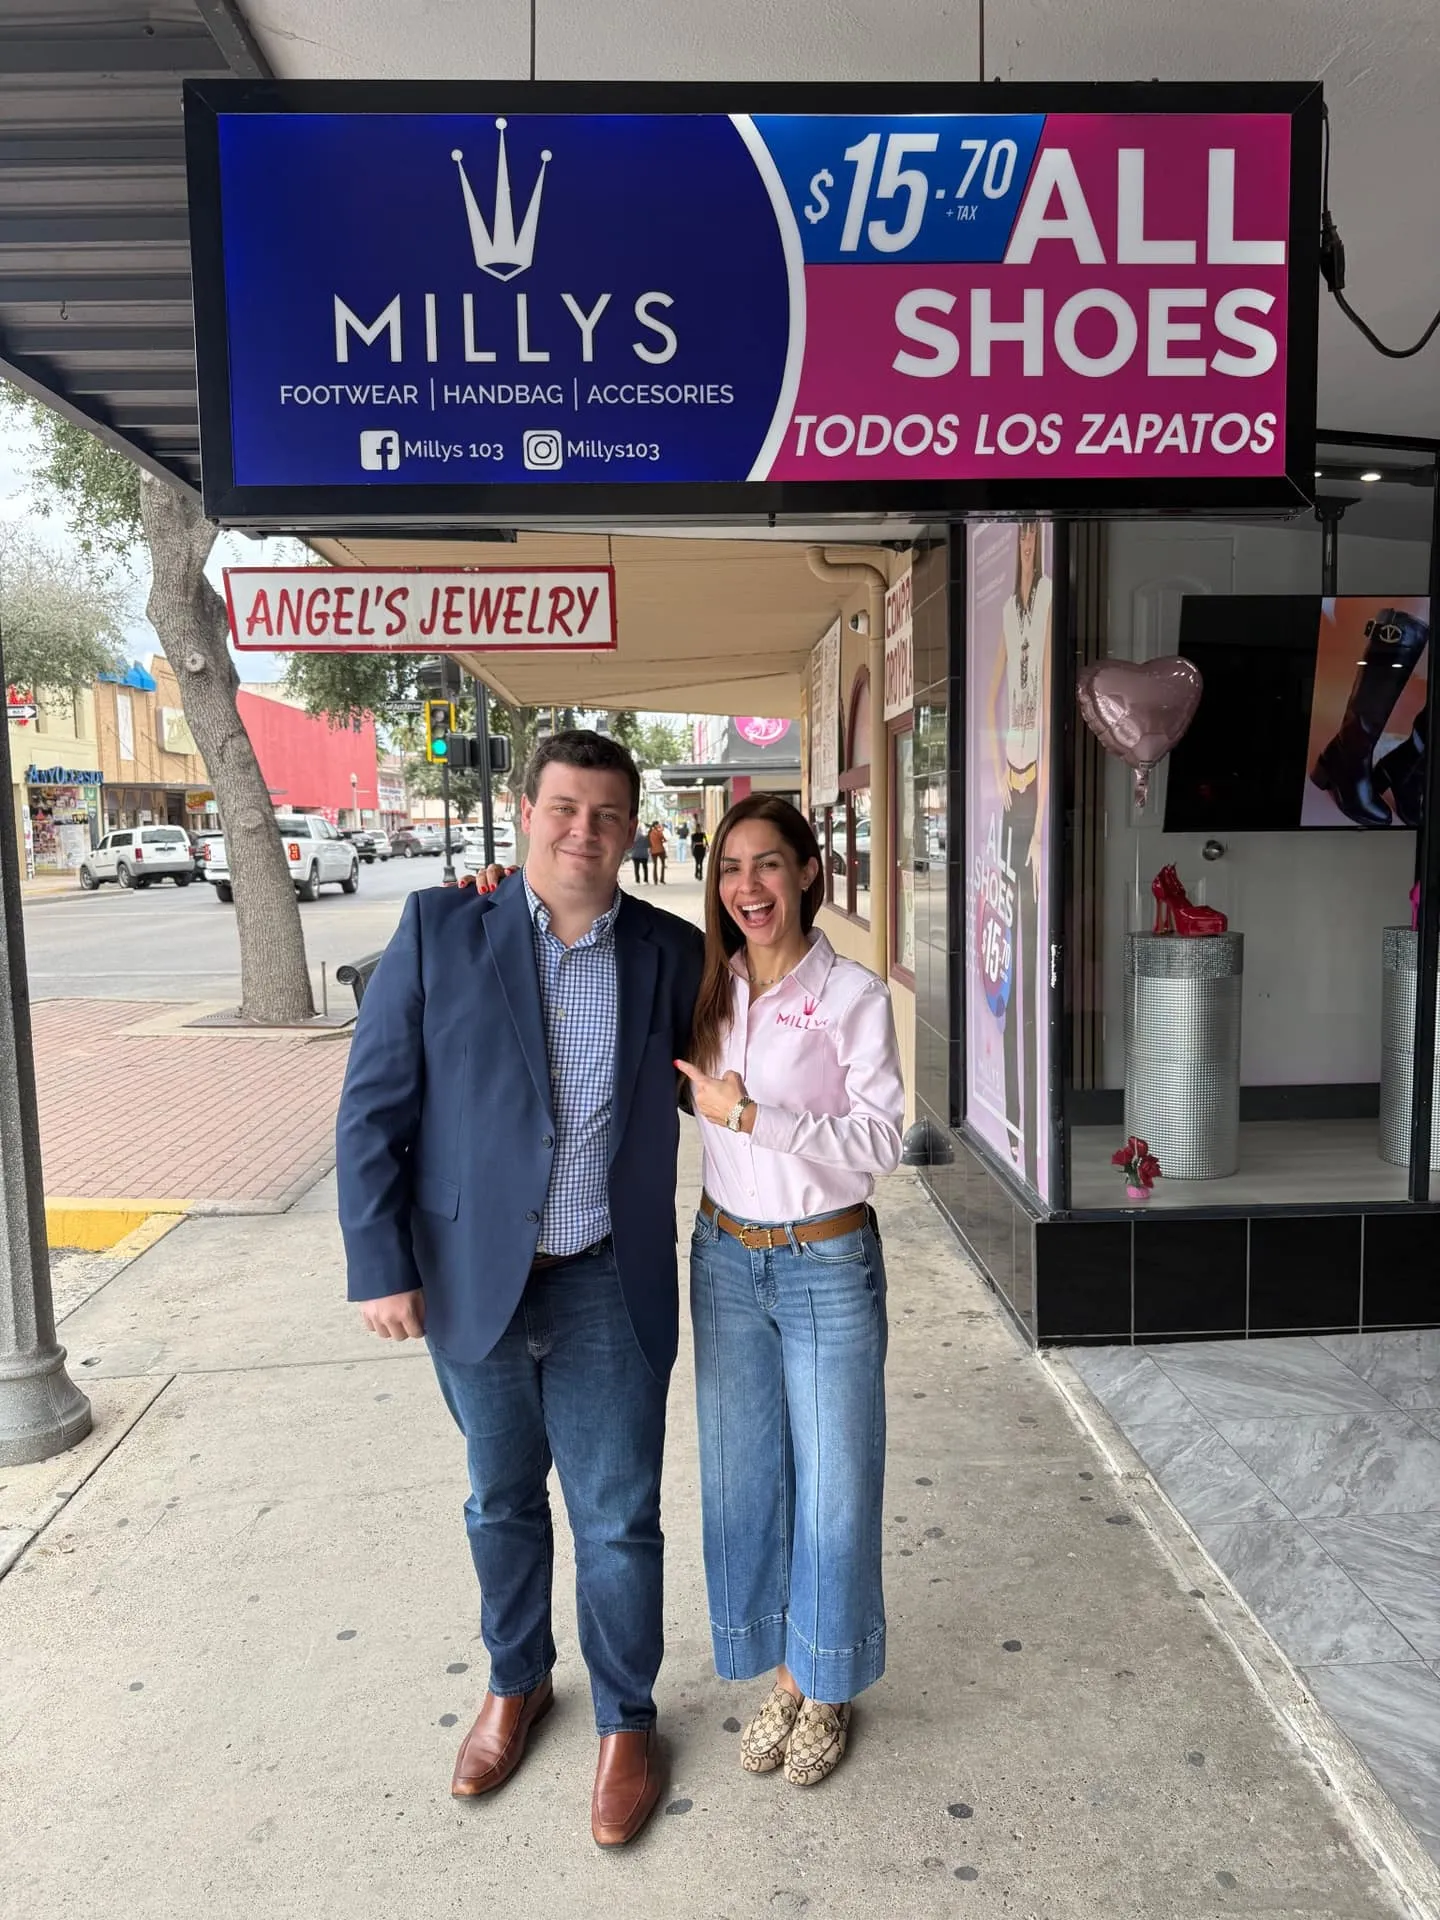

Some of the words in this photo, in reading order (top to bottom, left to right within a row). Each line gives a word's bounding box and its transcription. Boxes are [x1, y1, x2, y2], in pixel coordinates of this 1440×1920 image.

[956, 205, 979, 222] TAX
[1002, 148, 1286, 264] ALL
[334, 291, 678, 365] MILLYS
[892, 288, 1278, 378] SHOES
[279, 384, 418, 405] FOOTWEAR
[443, 384, 563, 405] HANDBAG
[587, 384, 734, 405] ACCESORIES
[404, 440, 463, 464] Millys
[469, 442, 504, 461] 103
[567, 440, 660, 464] Millys103
[794, 414, 960, 457] TODOS
[974, 414, 1063, 456] LOS
[1075, 412, 1277, 455] ZAPATOS
[246, 586, 408, 637] ANGEL'S
[419, 586, 600, 637] JEWELRY
[986, 812, 1016, 883] ALL
[974, 855, 1014, 928] SHOES
